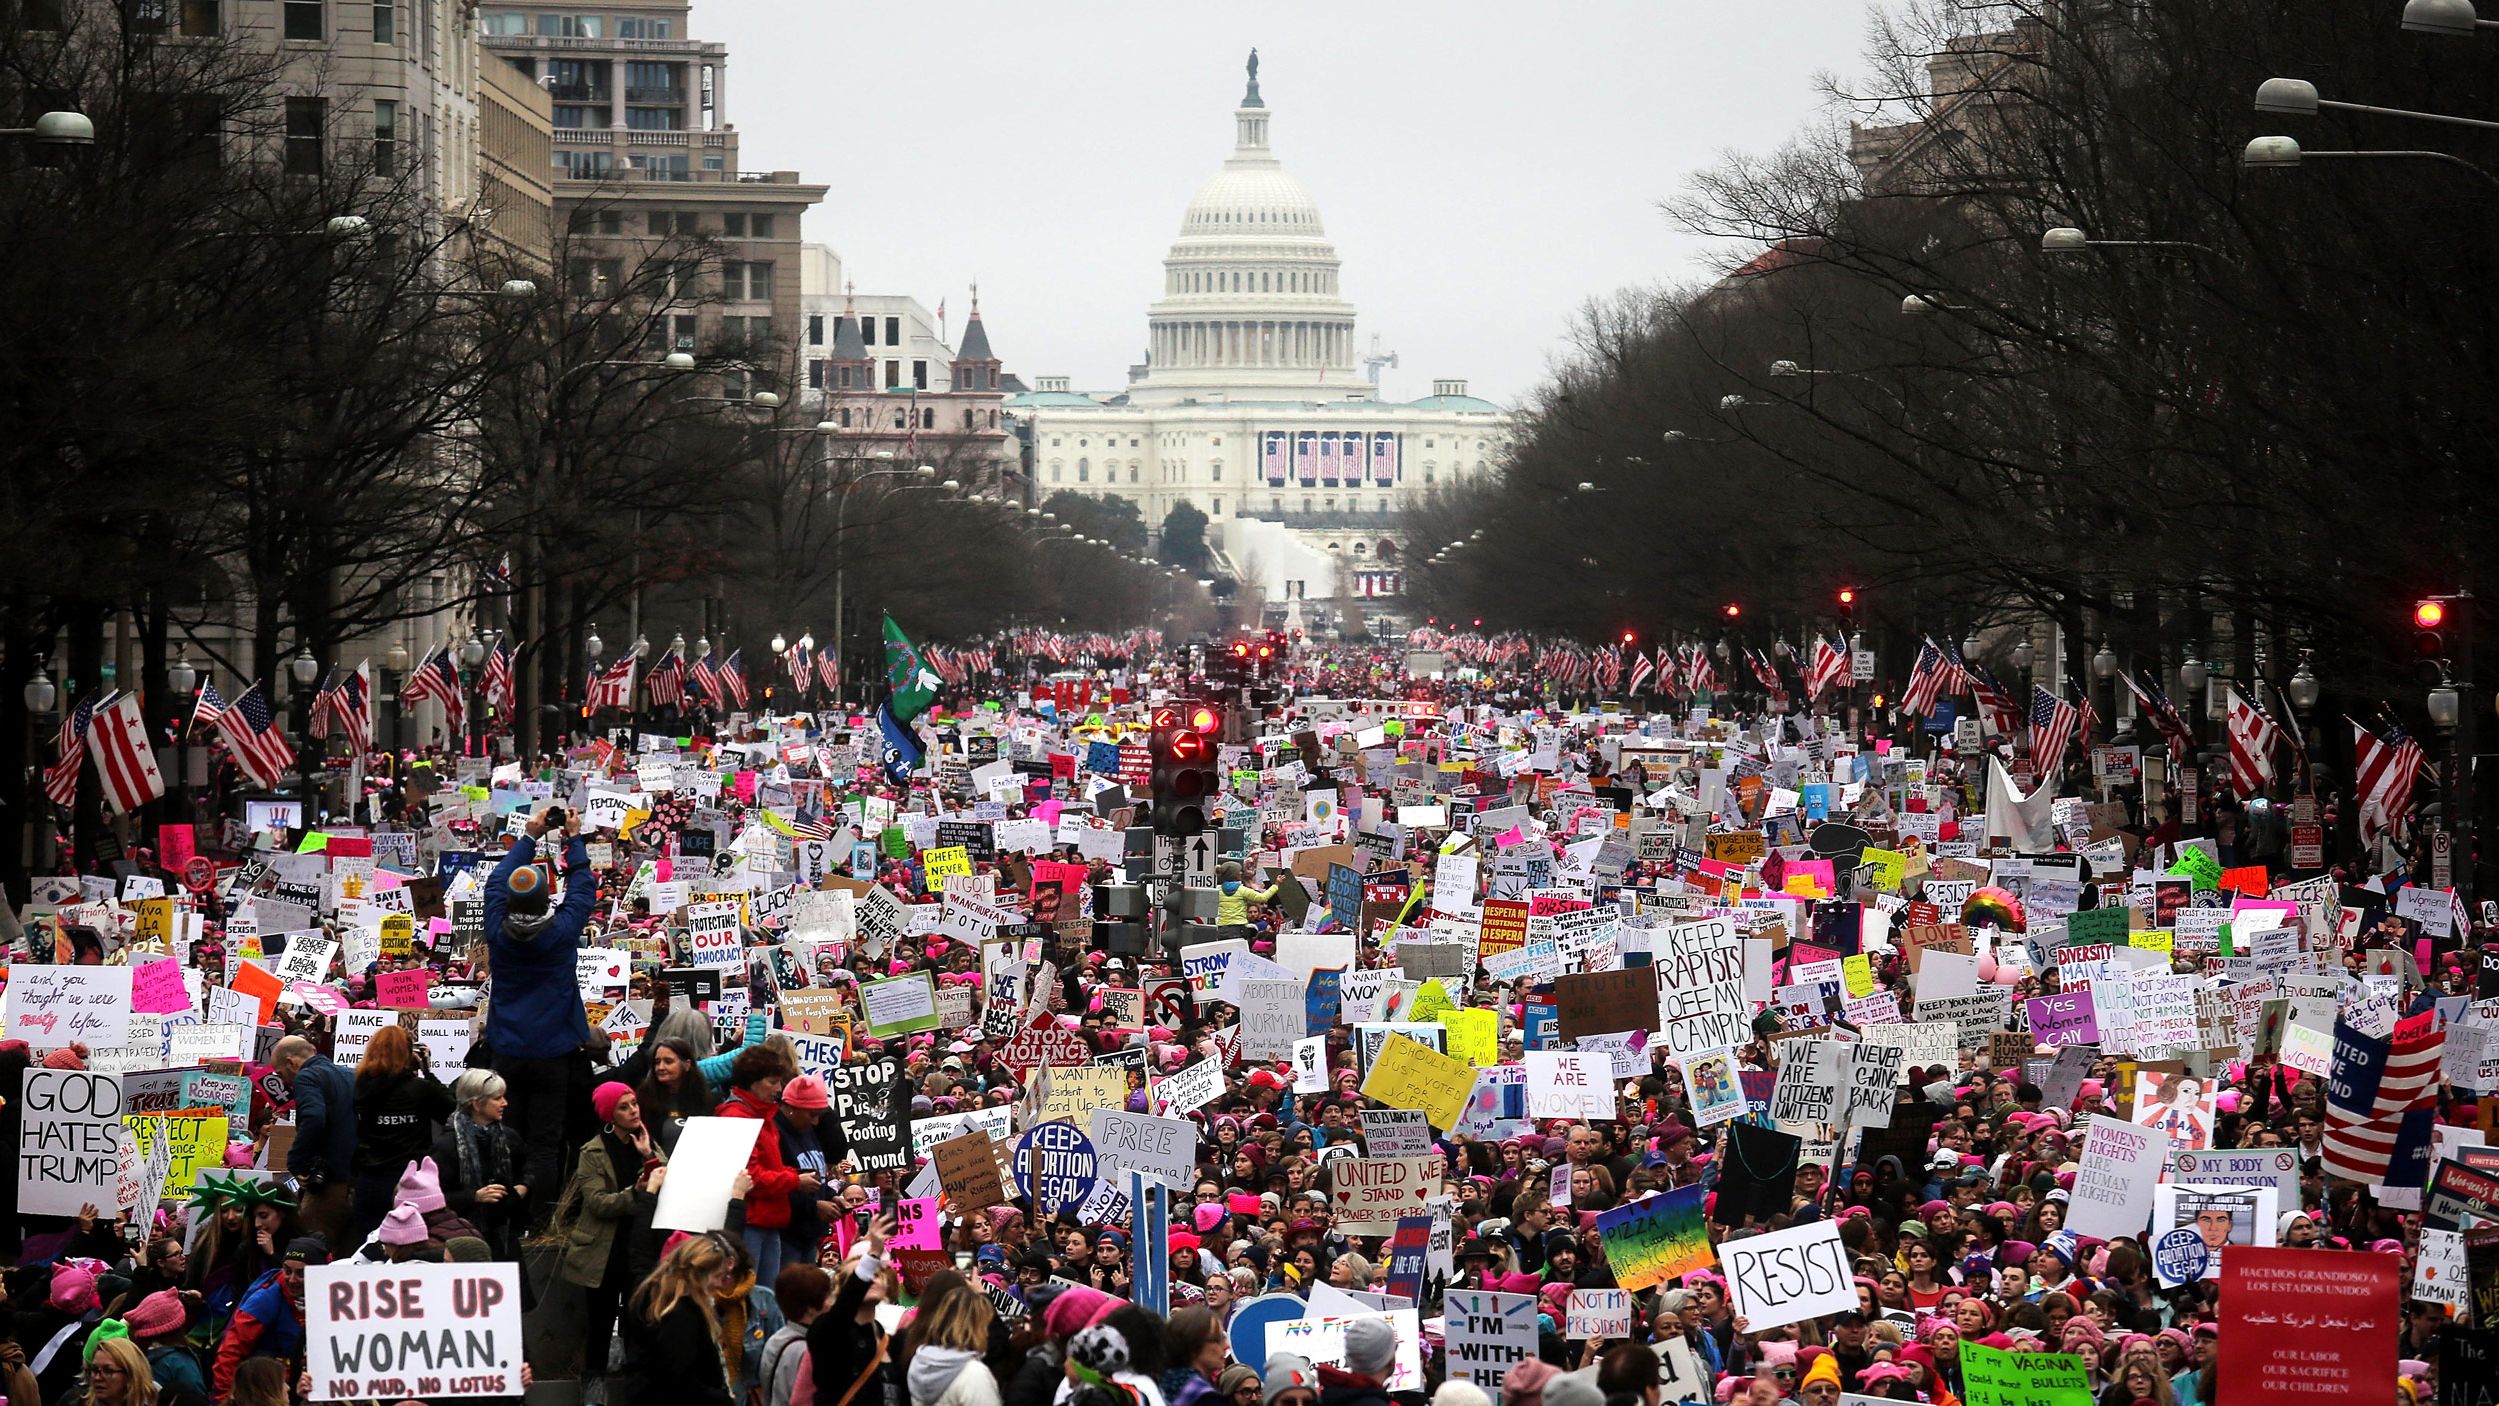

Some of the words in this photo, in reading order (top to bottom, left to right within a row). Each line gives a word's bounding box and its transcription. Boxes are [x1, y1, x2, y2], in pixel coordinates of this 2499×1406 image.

[1397, 778, 1420, 789] LOVE
[1228, 810, 1257, 819] STANDING
[1267, 810, 1288, 820] STAY
[682, 836, 710, 849] NOPE
[1719, 835, 1760, 843] TOGETHER
[1642, 847, 1667, 856] ARMY
[1678, 851, 1700, 863] TRUST
[1991, 846, 2012, 856] PEOPLE
[931, 864, 963, 876] NEVER
[1503, 863, 1513, 871] SHE
[1676, 858, 1699, 870] WOMEN
[1040, 866, 1065, 880] TEEN
[1330, 865, 1360, 885] LOVE
[1364, 877, 1380, 885] SAY
[963, 875, 993, 894] GOD
[693, 894, 744, 904] PROTECT
[866, 889, 900, 922] WHERE
[1641, 894, 1656, 905] WHY
[1664, 897, 1686, 908] MARCH
[1744, 900, 1774, 908] WOMEN
[1484, 906, 1517, 919] RESPETA
[1519, 908, 1527, 919] MI
[1582, 910, 1594, 918] FOR
[1597, 906, 1616, 914] THE
[143, 918, 159, 930] La
[227, 926, 256, 934] SEXISM
[382, 920, 411, 930] INAUGURATE
[1009, 923, 1042, 936] CAUTION
[1483, 918, 1525, 929] EXISTENCIA
[695, 932, 735, 948] OUR
[1482, 928, 1490, 938] O
[1491, 930, 1524, 943] ESPERA
[1669, 922, 1725, 956] KEEP
[1910, 923, 1963, 946] LOVE
[381, 938, 412, 948] RESISTANCE
[693, 946, 742, 965] DEMOCRACY
[2058, 944, 2114, 965] DIVERSITY
[2261, 946, 2288, 957] FUTURE
[1656, 945, 1745, 991] RAPISTS
[2207, 958, 2226, 969] NO
[2229, 959, 2252, 969] RACISM
[2255, 959, 2297, 971] DAUGHTERS
[31, 975, 53, 984] and
[63, 976, 87, 988] you
[994, 974, 1018, 988] WE
[21, 992, 64, 1010] thought
[69, 995, 84, 1005] we
[89, 995, 117, 1005] were
[214, 991, 240, 1008] AND
[395, 996, 416, 1004] RUN
[990, 986, 1017, 1000] WILL
[1103, 992, 1138, 1001] AMERICA
[1243, 982, 1305, 1004] ABORTION
[1667, 987, 1712, 1019] OFF
[1714, 983, 1744, 1012] MY
[717, 1005, 734, 1014] WE
[989, 997, 1017, 1012] NOT
[1103, 999, 1128, 1008] NEEDS
[1266, 1002, 1279, 1011] IS
[1918, 998, 1946, 1012] KEEP
[1971, 992, 2005, 1006] HANDS
[2039, 998, 2076, 1014] Yes
[985, 1010, 1017, 1024] BACK
[1528, 1006, 1547, 1015] ACLU
[1926, 1010, 1946, 1021] AND
[1947, 1009, 1971, 1019] YOUR
[348, 1015, 383, 1026] MAKE
[983, 1020, 1013, 1036] DOWN
[1242, 1014, 1306, 1035] NORMAL
[2032, 1016, 2092, 1032] Women
[421, 1029, 448, 1037] SMALL
[1021, 1028, 1066, 1045] STOP
[1670, 1011, 1753, 1050] CAMPUS
[2045, 1029, 2082, 1048] CAN
[1993, 1033, 2032, 1048] BASIC
[1000, 1044, 1092, 1060] VIOLENCE
[1221, 1030, 1242, 1071] Solidarity
[1789, 1041, 1821, 1065] WE
[1851, 1045, 1903, 1068] NEVER
[1558, 1057, 1580, 1071] WE
[2282, 1049, 2330, 1075] WOMEN
[833, 1062, 895, 1089] STOP
[1053, 1068, 1093, 1080] WANT
[1099, 1068, 1121, 1080] MY
[1380, 1058, 1420, 1078] JUST
[1424, 1075, 1461, 1102] VOTED
[1554, 1072, 1588, 1086] ARE
[1780, 1066, 1814, 1084] ARE
[1856, 1067, 1898, 1089] GOING
[201, 1077, 218, 1090] Keep
[25, 1072, 121, 1118] GOD
[1850, 1086, 1892, 1117] BACK
[1383, 1087, 1450, 1121] JOFFREY
[1748, 1099, 1768, 1112] FOR
[1774, 1101, 1828, 1121] UNITED
[22, 1120, 119, 1154] HATES
[840, 1123, 896, 1143] Footing
[1031, 1124, 1083, 1151] KEEP
[1102, 1117, 1177, 1155] FREE
[2092, 1124, 2148, 1150] WOMEN'S
[1331, 1149, 1344, 1158] END
[1369, 1140, 1399, 1152] AMERICAN
[2088, 1140, 2138, 1164] RIGHTS
[844, 1147, 906, 1175] Around
[2084, 1155, 2113, 1173] ARE
[2202, 1159, 2226, 1173] MY
[2229, 1158, 2263, 1172] BODY
[20, 1155, 117, 1186] TRUMP
[1419, 1160, 1440, 1180] WE
[2082, 1169, 2132, 1192] HUMAN
[1361, 1186, 1404, 1202] STAND
[2078, 1184, 2127, 1207] RIGHTS
[1336, 1207, 1373, 1222] POWER
[1380, 1210, 1391, 1221] TO
[1606, 1218, 1659, 1242] PIZZA
[2163, 1228, 2194, 1248] KEEP
[2157, 1247, 2206, 1266] ABORTION
[1733, 1238, 1847, 1315] RESIST
[2163, 1262, 2203, 1283] LEGAL
[2240, 1266, 2295, 1279] HACEMOS
[2298, 1269, 2369, 1283] GRANDIOSO
[2369, 1273, 2379, 1283] A
[2246, 1280, 2270, 1291] LOS
[2271, 1281, 2325, 1294] ESTADOS
[2326, 1285, 2371, 1296] UNIDOS
[2414, 1282, 2455, 1301] HUMAN
[329, 1279, 424, 1321] RISE
[453, 1278, 504, 1318] UP
[1571, 1292, 1605, 1311] NOT
[1608, 1290, 1628, 1308] MY
[1468, 1316, 1503, 1335] I'M
[1567, 1315, 1630, 1334] PRESIDENT
[330, 1329, 508, 1374] WOMAN.
[1458, 1343, 1524, 1362] WITH
[2273, 1350, 2298, 1359] OUR
[2300, 1350, 2340, 1362] LABOR
[2011, 1355, 2076, 1372] VAGINA
[2262, 1365, 2288, 1375] OUR
[2289, 1366, 2349, 1378] SACRIFICE
[329, 1379, 359, 1398] NO
[367, 1378, 413, 1397] MUD,
[418, 1378, 441, 1394] NO
[449, 1375, 506, 1393] LOTUS
[2031, 1377, 2086, 1389] BULLETS
[2262, 1380, 2288, 1391] OUR
[2290, 1381, 2349, 1394] CHILDREN
